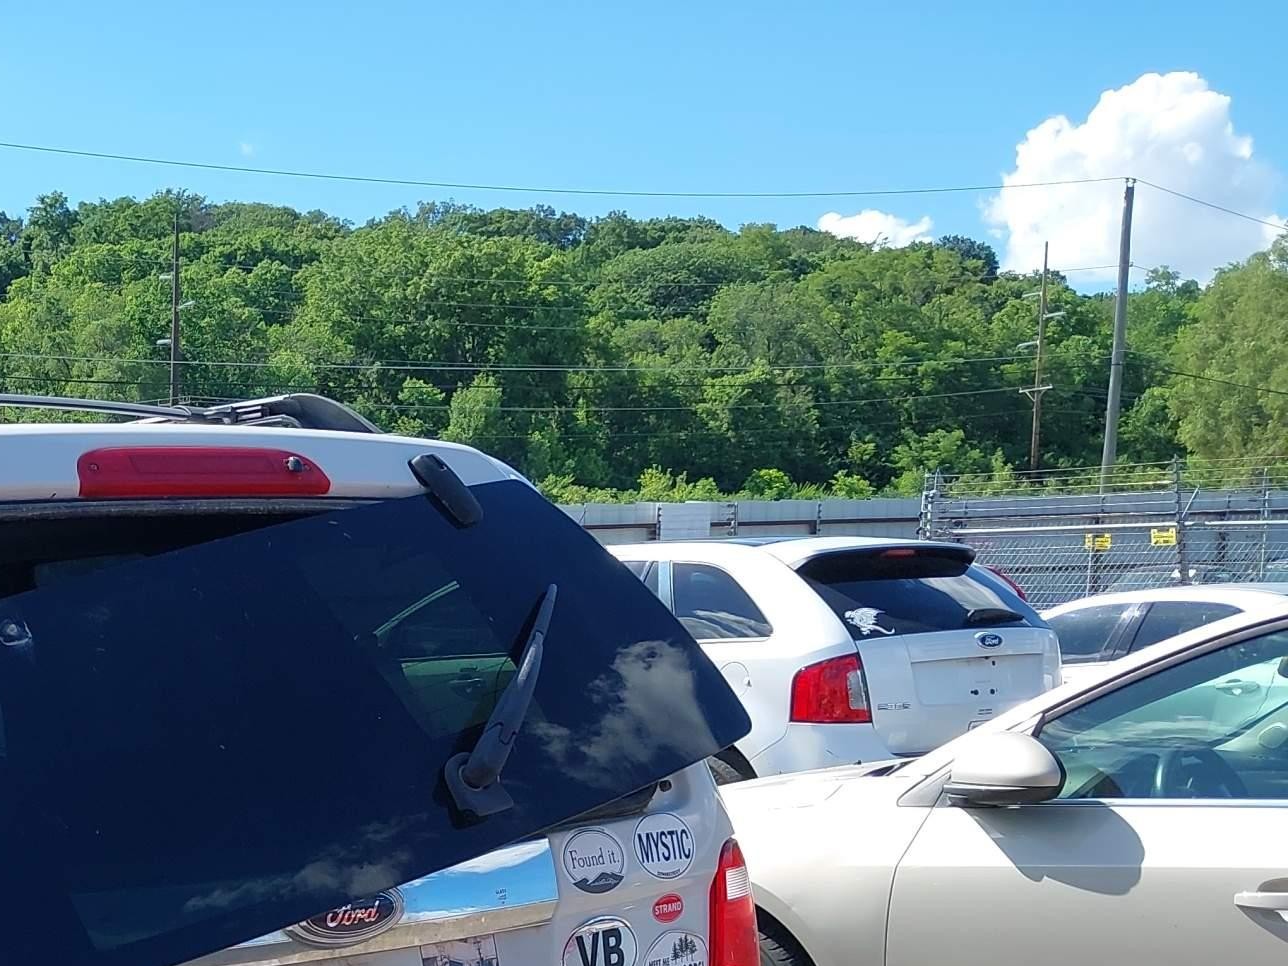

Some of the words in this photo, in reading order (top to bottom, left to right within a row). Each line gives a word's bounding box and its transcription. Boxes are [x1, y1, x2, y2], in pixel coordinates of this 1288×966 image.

[637, 829, 691, 864] MYSTIC
[569, 847, 605, 869] Found
[607, 850, 620, 863] it.
[326, 900, 380, 927] Ford
[654, 901, 682, 915] STRAND
[662, 957, 670, 966] ME
